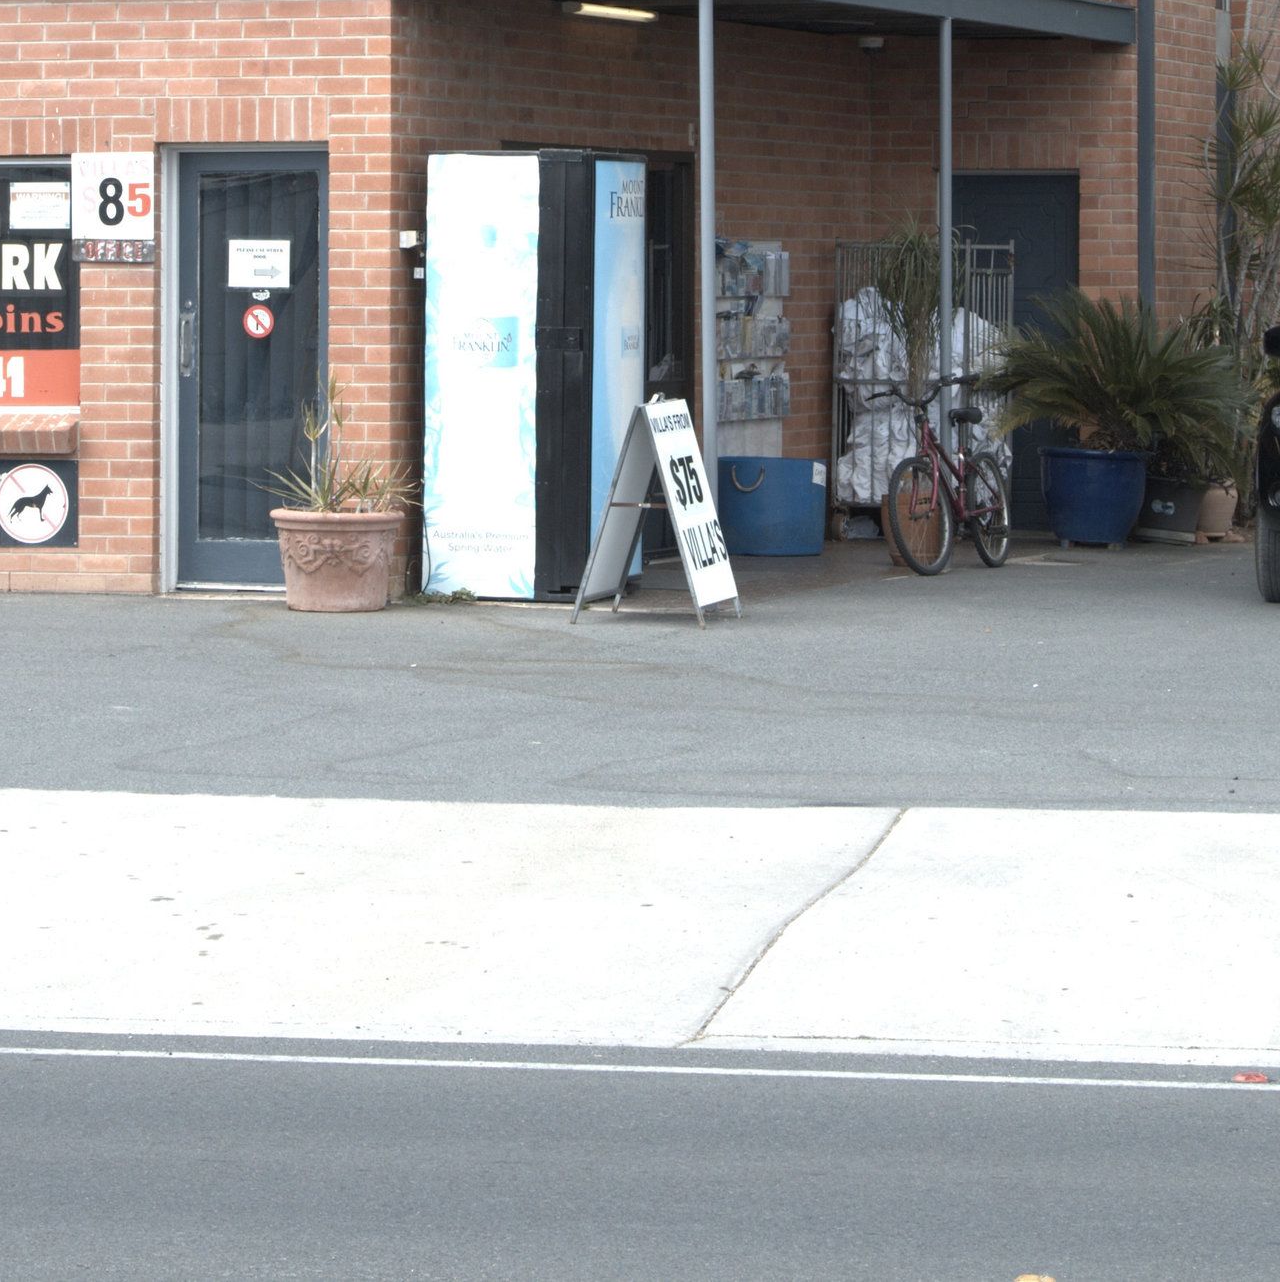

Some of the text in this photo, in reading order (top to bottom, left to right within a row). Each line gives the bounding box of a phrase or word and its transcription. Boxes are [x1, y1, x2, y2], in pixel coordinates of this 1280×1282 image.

[622, 179, 644, 195] MOUNT
[84, 241, 143, 261] OFFICE
[670, 455, 704, 511] $75
[683, 519, 728, 571] VILLA'S
